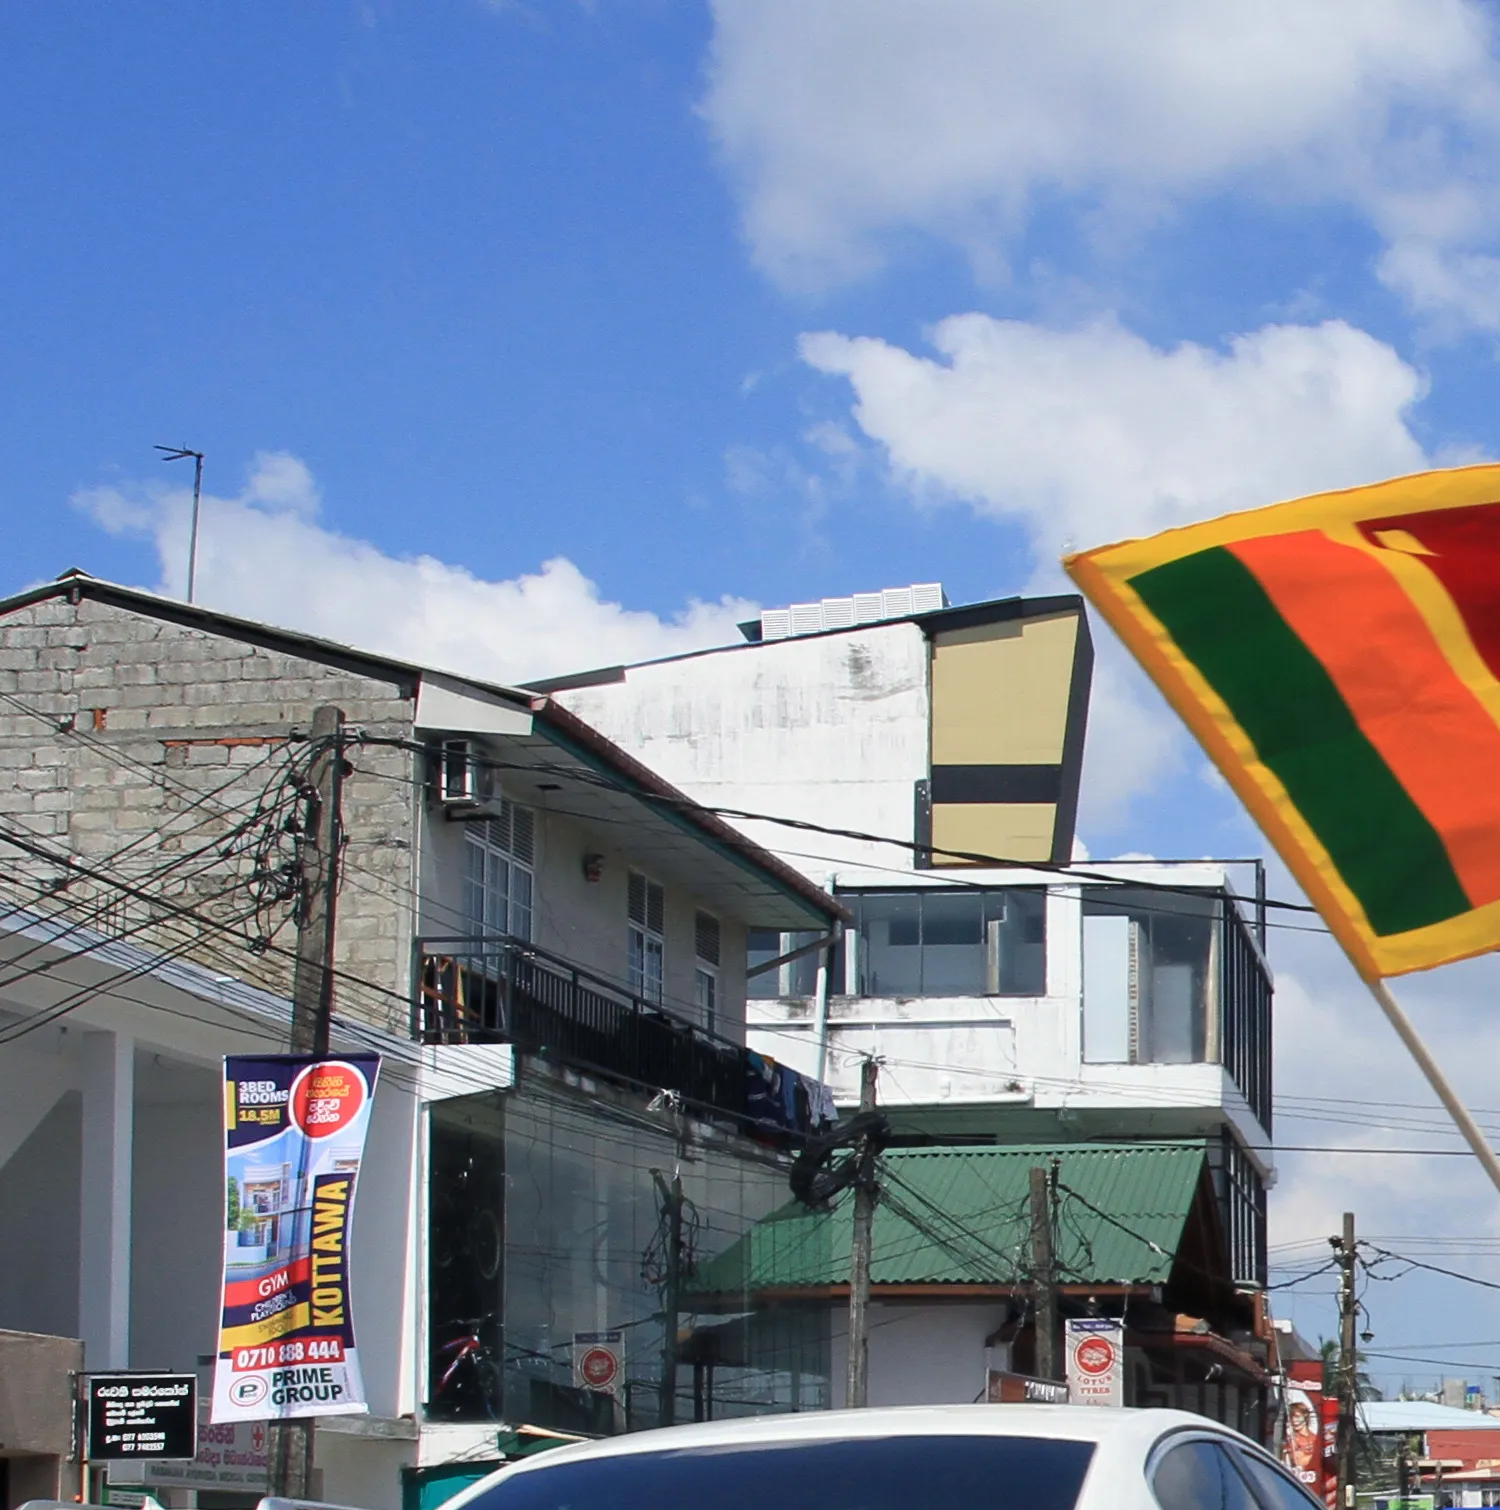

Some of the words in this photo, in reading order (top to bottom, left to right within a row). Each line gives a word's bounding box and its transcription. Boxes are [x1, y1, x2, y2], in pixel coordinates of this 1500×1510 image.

[239, 1081, 276, 1093] 3BED
[240, 1091, 289, 1104] ROOMS
[239, 1109, 281, 1122] 18.5M
[312, 1181, 349, 1327] KOTTAWA
[259, 1271, 289, 1296] GYM
[237, 1347, 275, 1368] 0710
[279, 1343, 304, 1362] 888
[308, 1341, 340, 1360] 444
[272, 1368, 333, 1388] PRIME
[272, 1384, 343, 1405] GROUP
[1080, 1386, 1111, 1395] TYRES
